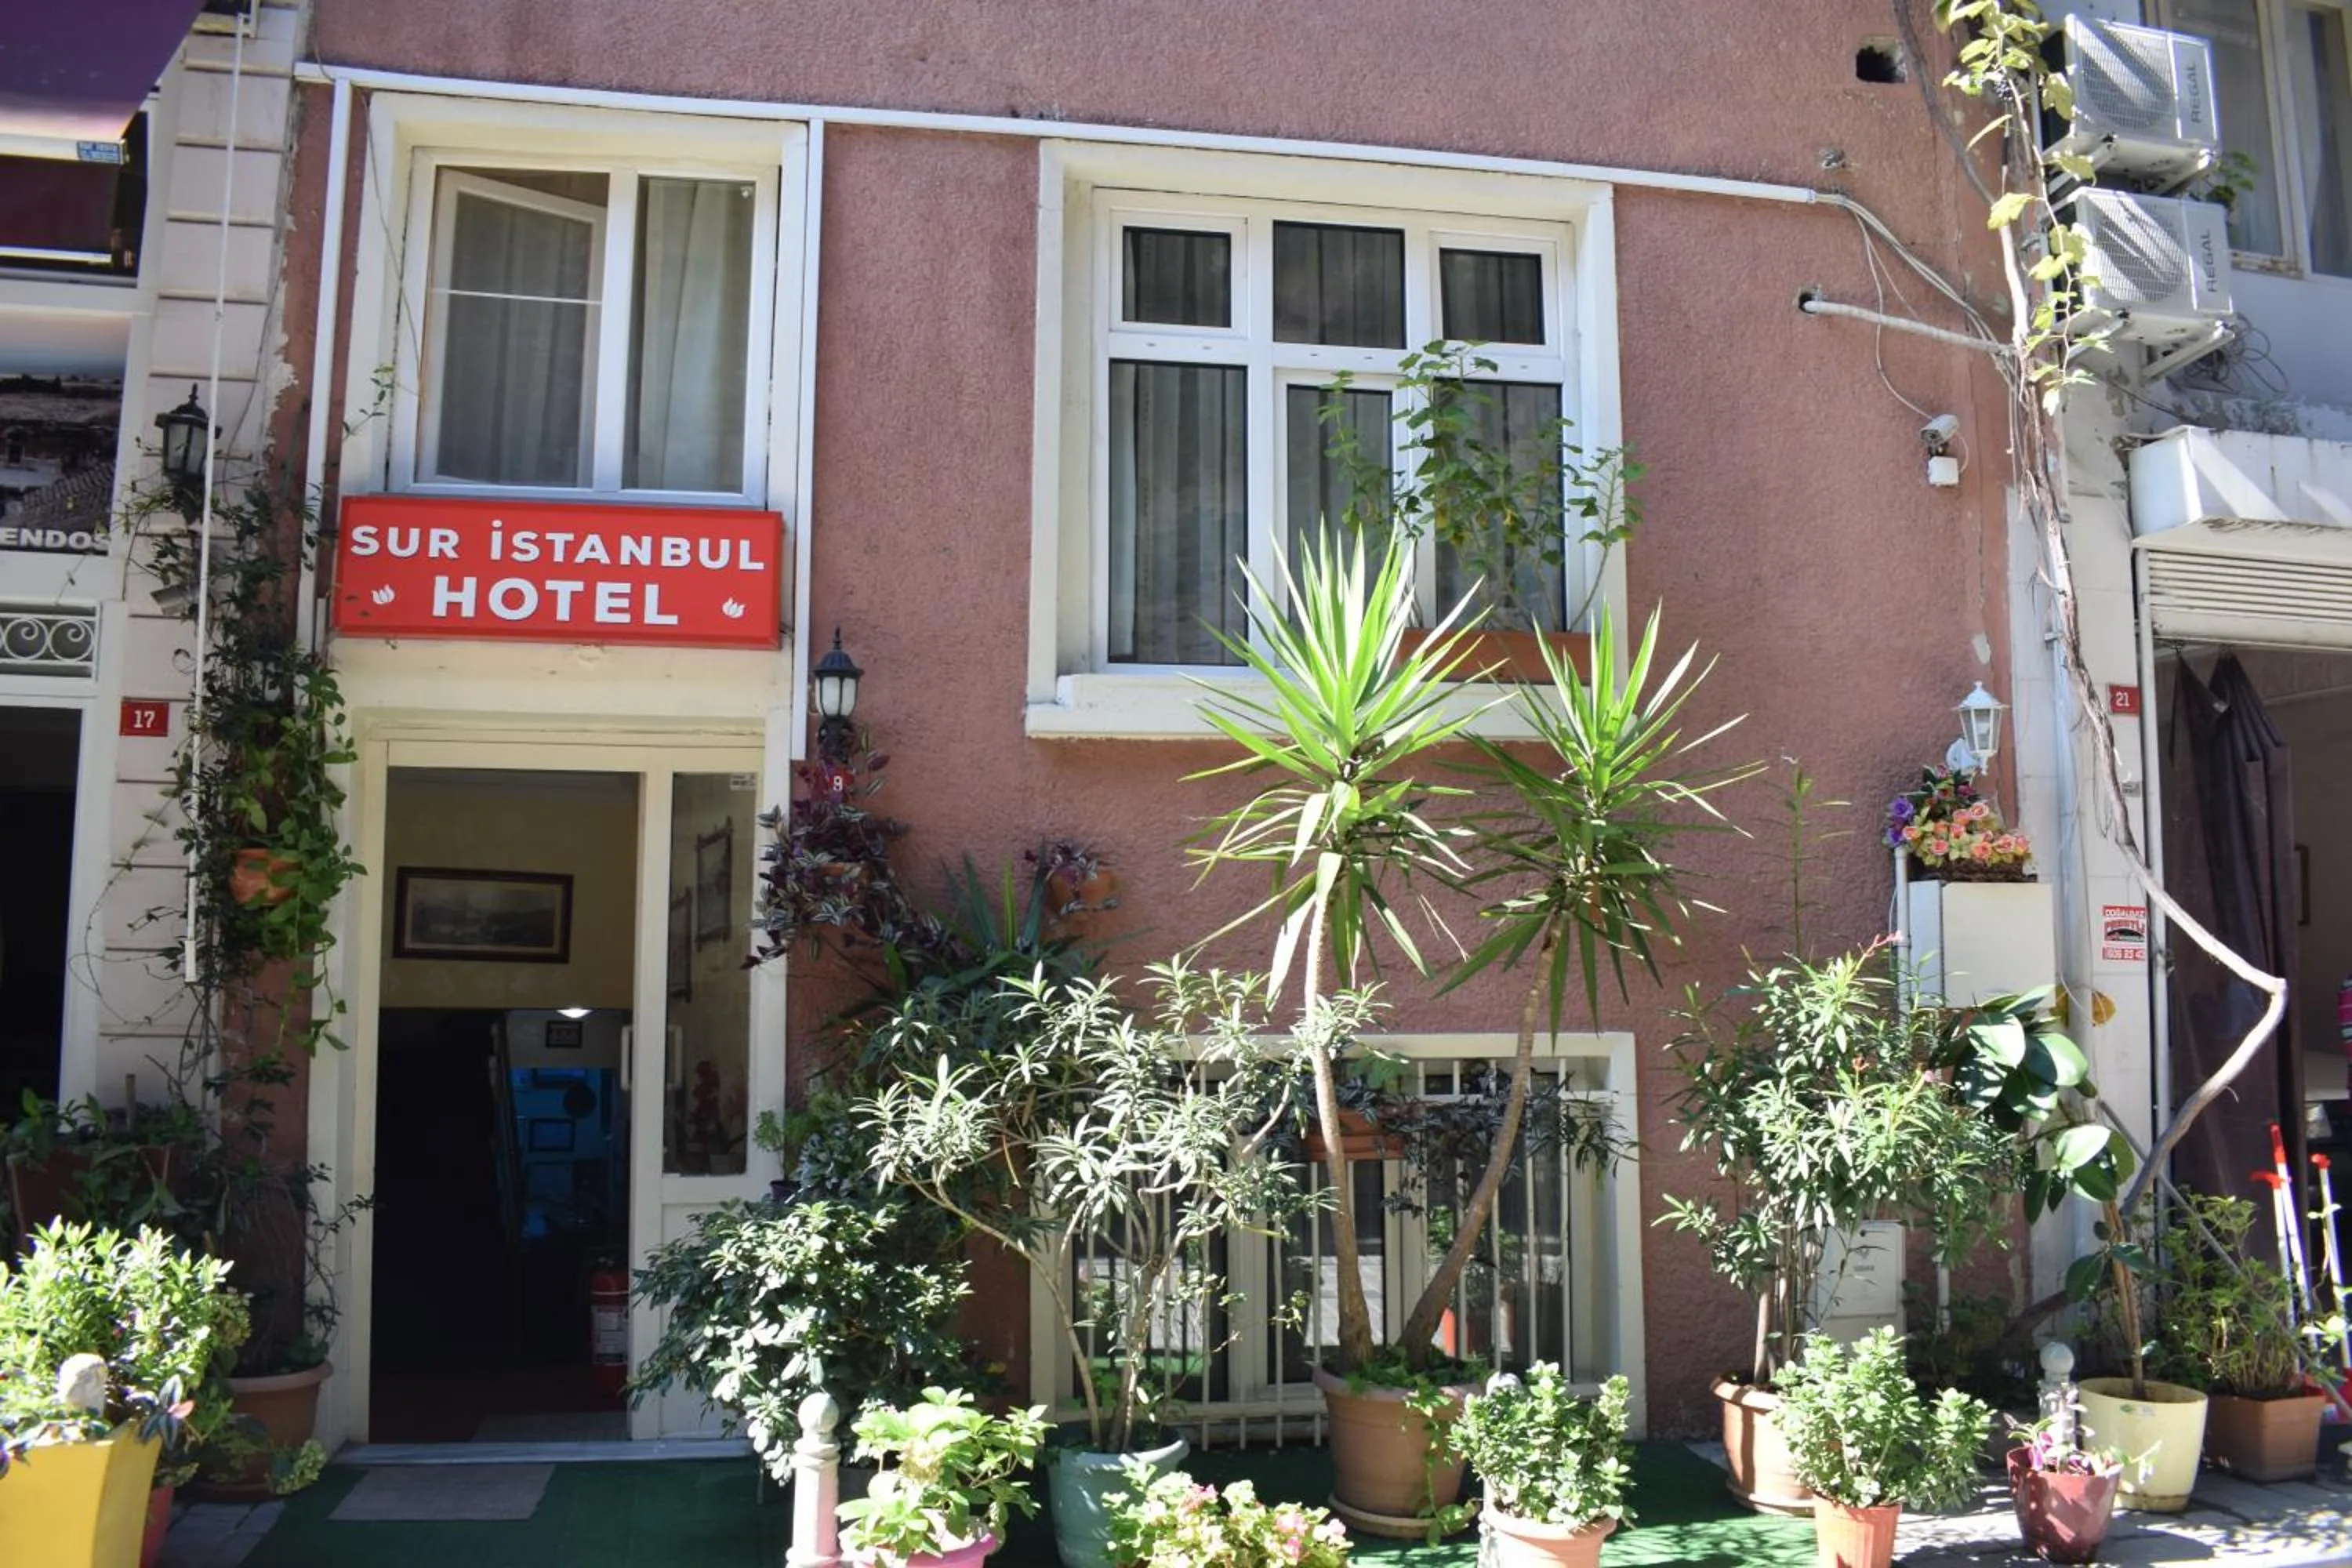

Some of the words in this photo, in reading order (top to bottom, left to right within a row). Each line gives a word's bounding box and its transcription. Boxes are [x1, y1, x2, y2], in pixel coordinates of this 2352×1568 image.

[2186, 61, 2202, 123] REGAL
[2200, 228, 2218, 292] REGAL
[350, 525, 459, 558] SUR
[490, 520, 764, 570] İSTANBUL
[432, 575, 679, 625] HOTEL
[134, 710, 155, 728] 17
[2116, 692, 2129, 706] 21
